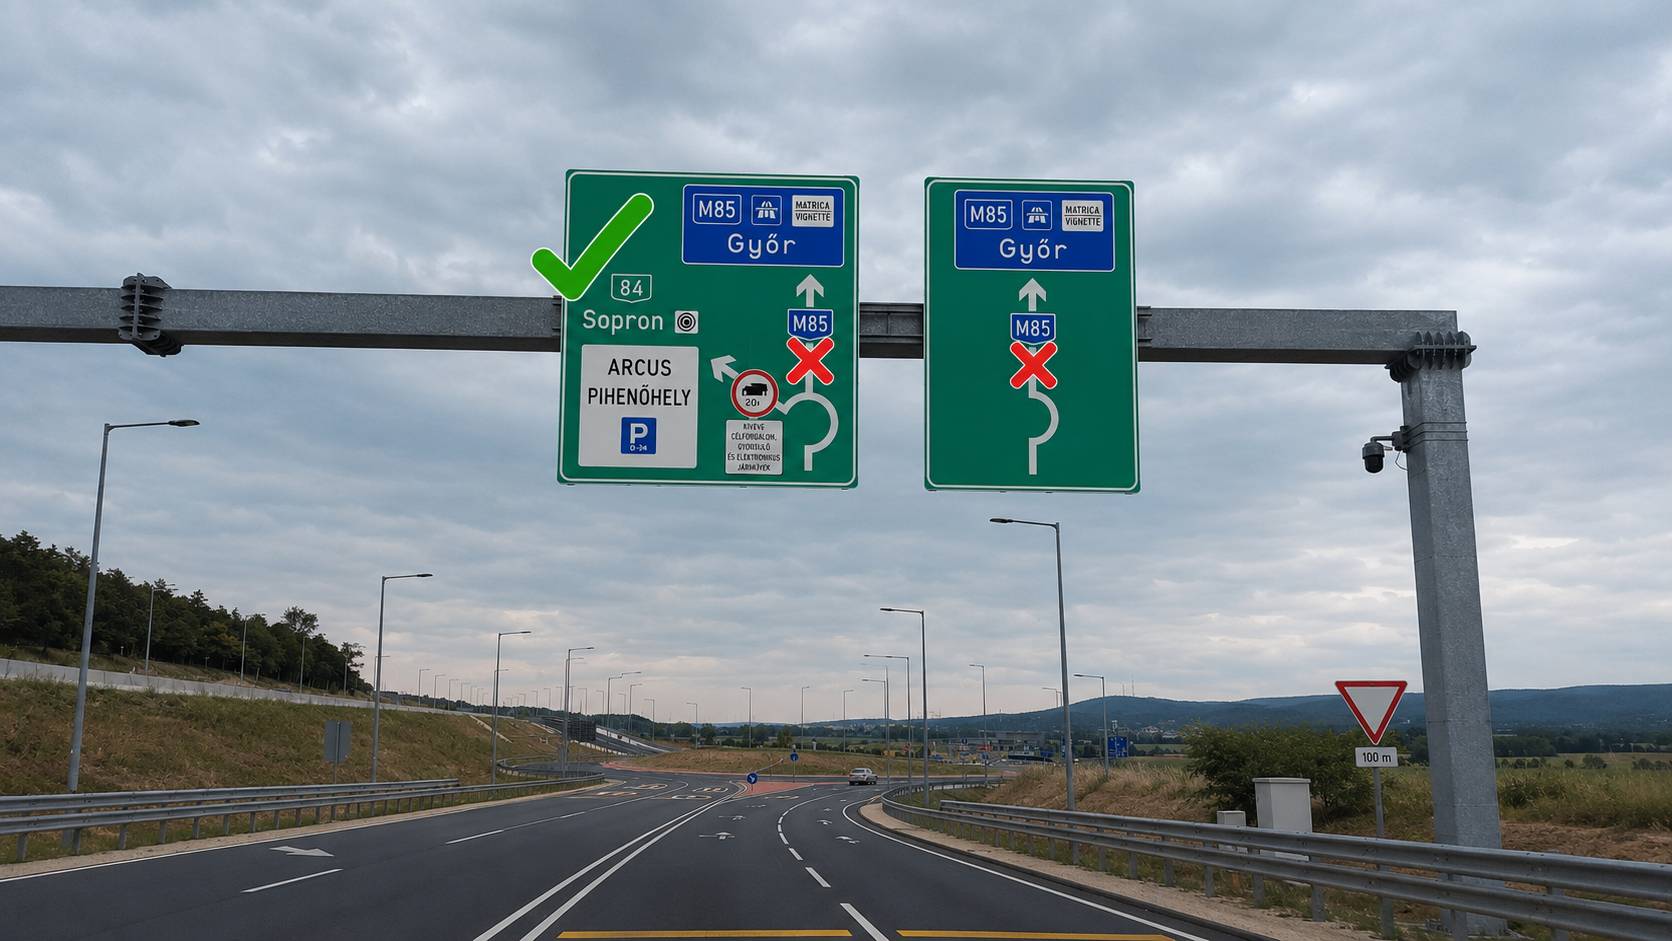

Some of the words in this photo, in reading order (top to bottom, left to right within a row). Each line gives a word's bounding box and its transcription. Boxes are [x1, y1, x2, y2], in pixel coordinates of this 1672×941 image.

[698, 200, 736, 219] M85
[795, 200, 830, 210] MATRICA
[970, 205, 1007, 224] M85
[1065, 205, 1100, 215] MATRICA
[795, 212, 831, 222] VIGNETTE
[1065, 217, 1101, 226] VIGNETTE
[727, 232, 797, 260] Győr
[999, 237, 1068, 265] Győr
[619, 279, 644, 297] 84
[582, 309, 664, 336] Sopron
[792, 314, 829, 333] M85
[1015, 318, 1051, 337] M85
[607, 358, 672, 377] ARCUS
[587, 383, 692, 407] PIHENŐHELY
[630, 423, 649, 444] P
[1362, 751, 1379, 763] 100
[1382, 754, 1392, 763] m
